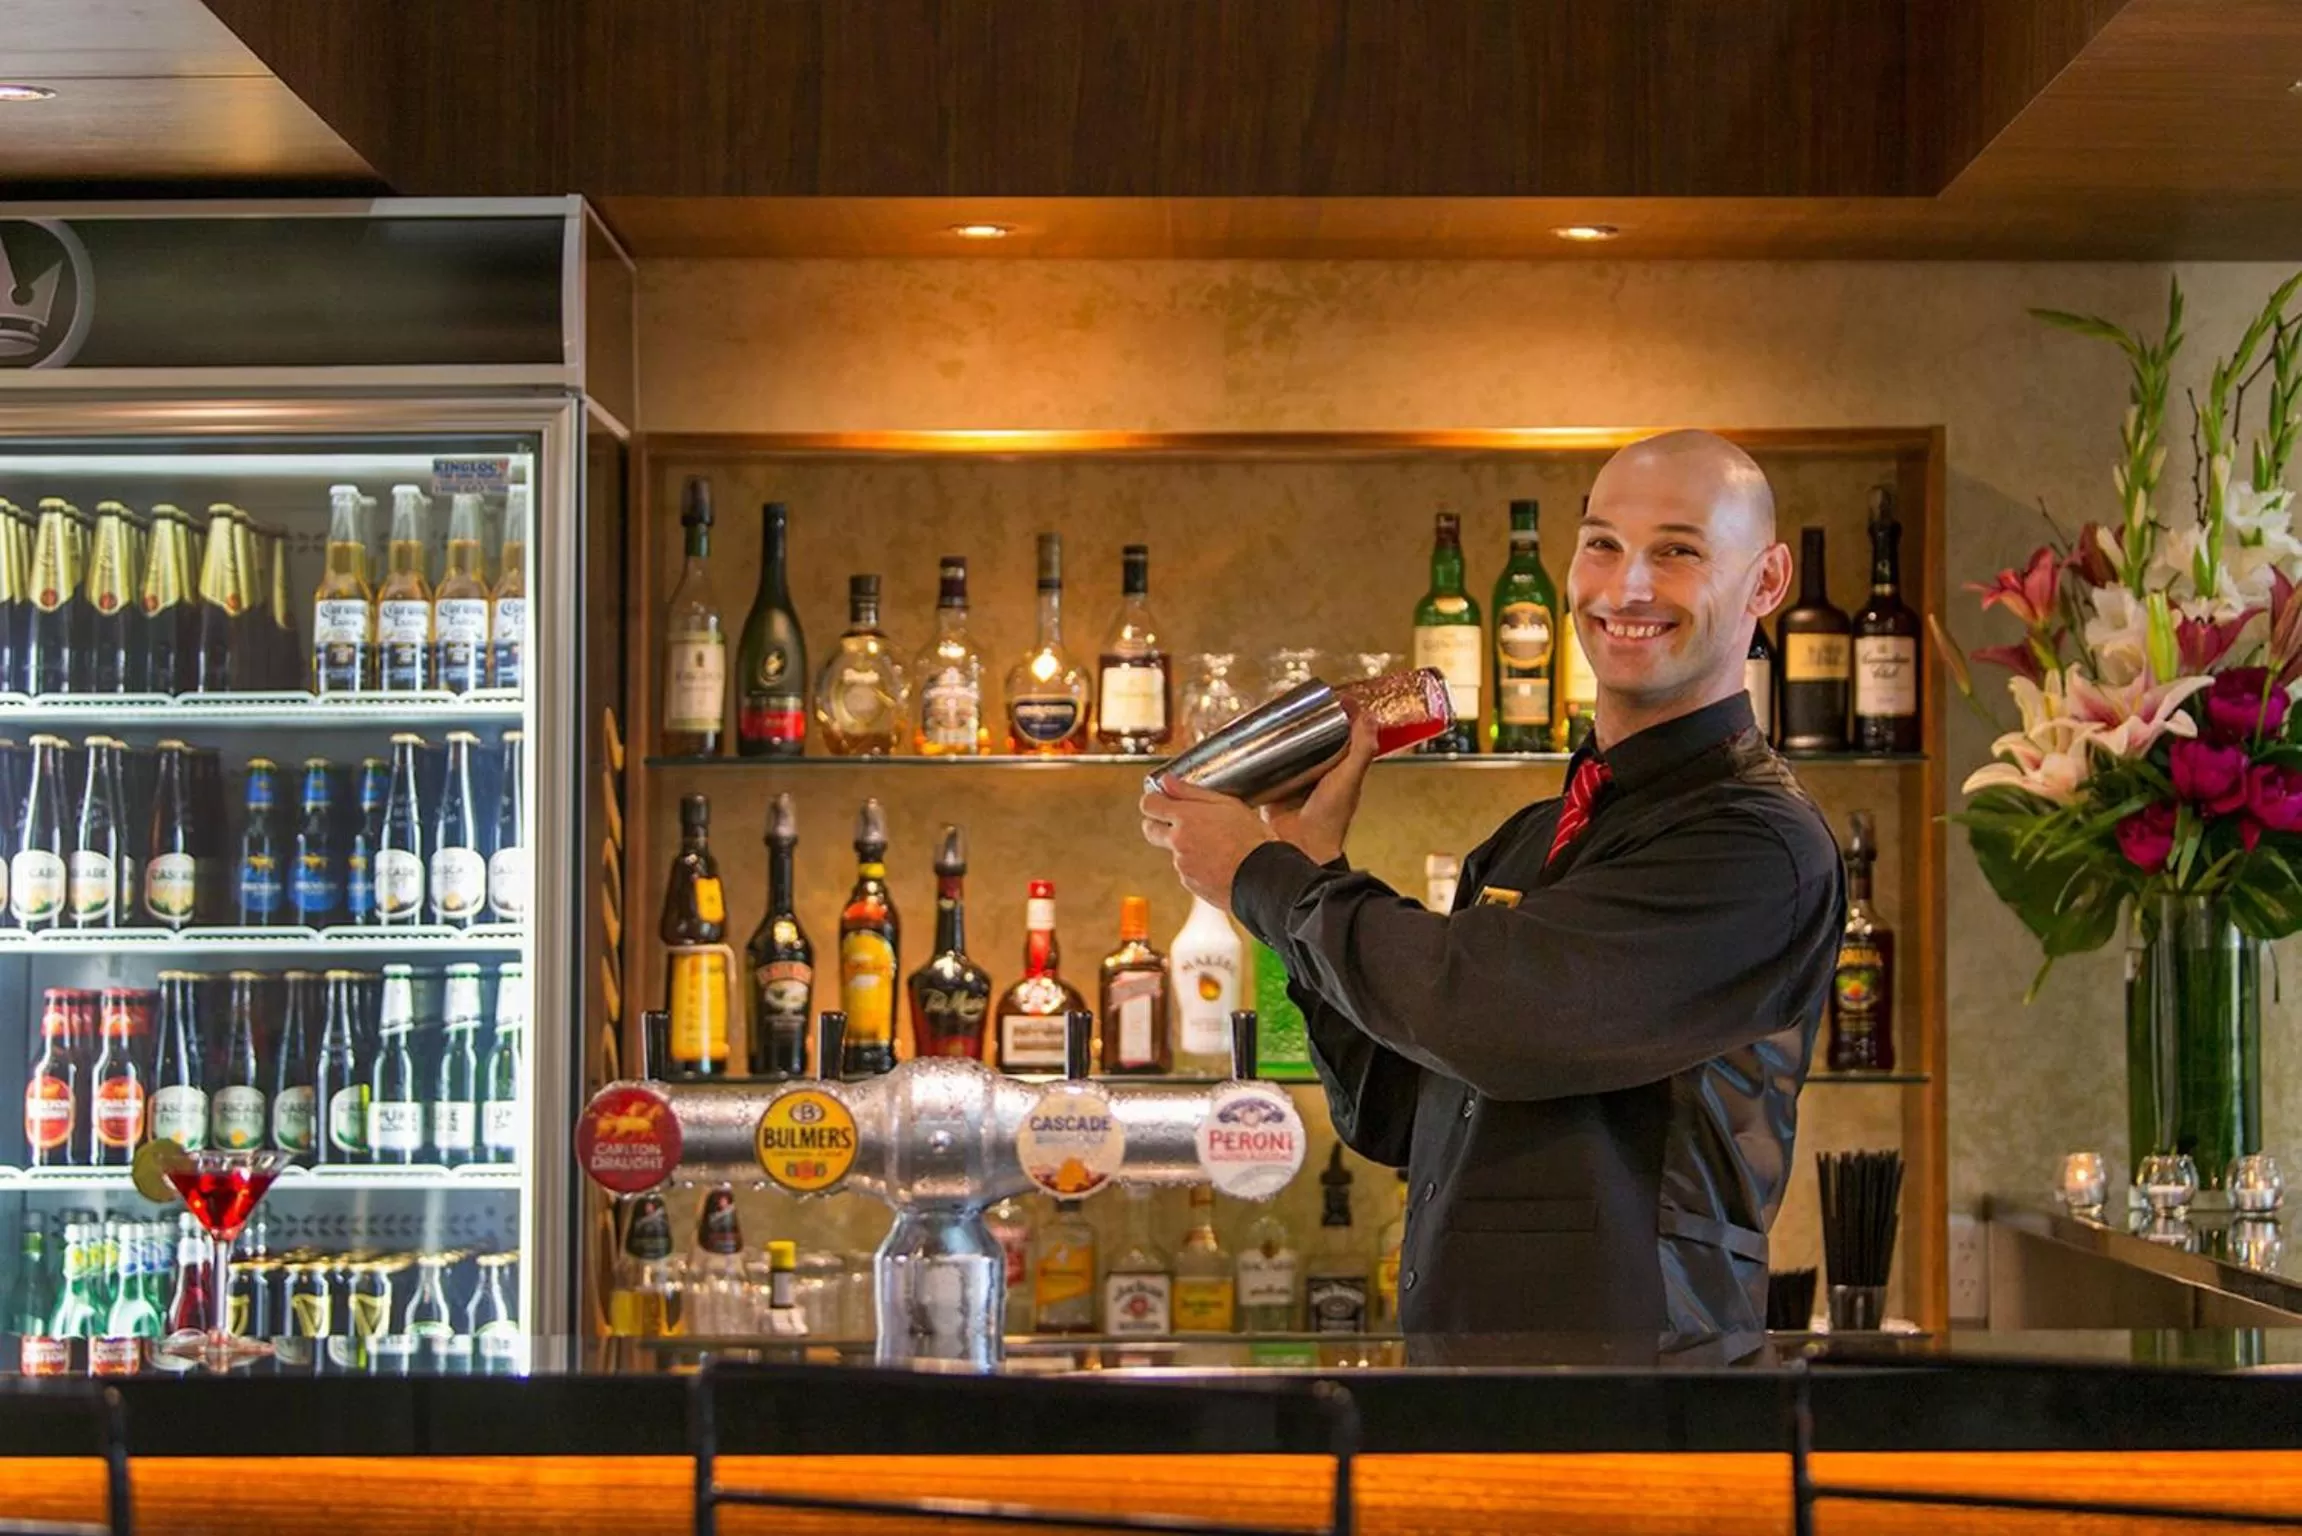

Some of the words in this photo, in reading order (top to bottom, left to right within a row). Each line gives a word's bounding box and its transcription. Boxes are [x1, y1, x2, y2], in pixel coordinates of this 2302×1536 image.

[801, 1104, 815, 1119] B
[1030, 1115, 1112, 1131] CASCADE
[764, 1127, 852, 1149] BULMERS
[1209, 1130, 1294, 1151] PERONI
[594, 1141, 662, 1155] CARLTON
[590, 1156, 664, 1171] DRAUGHT
